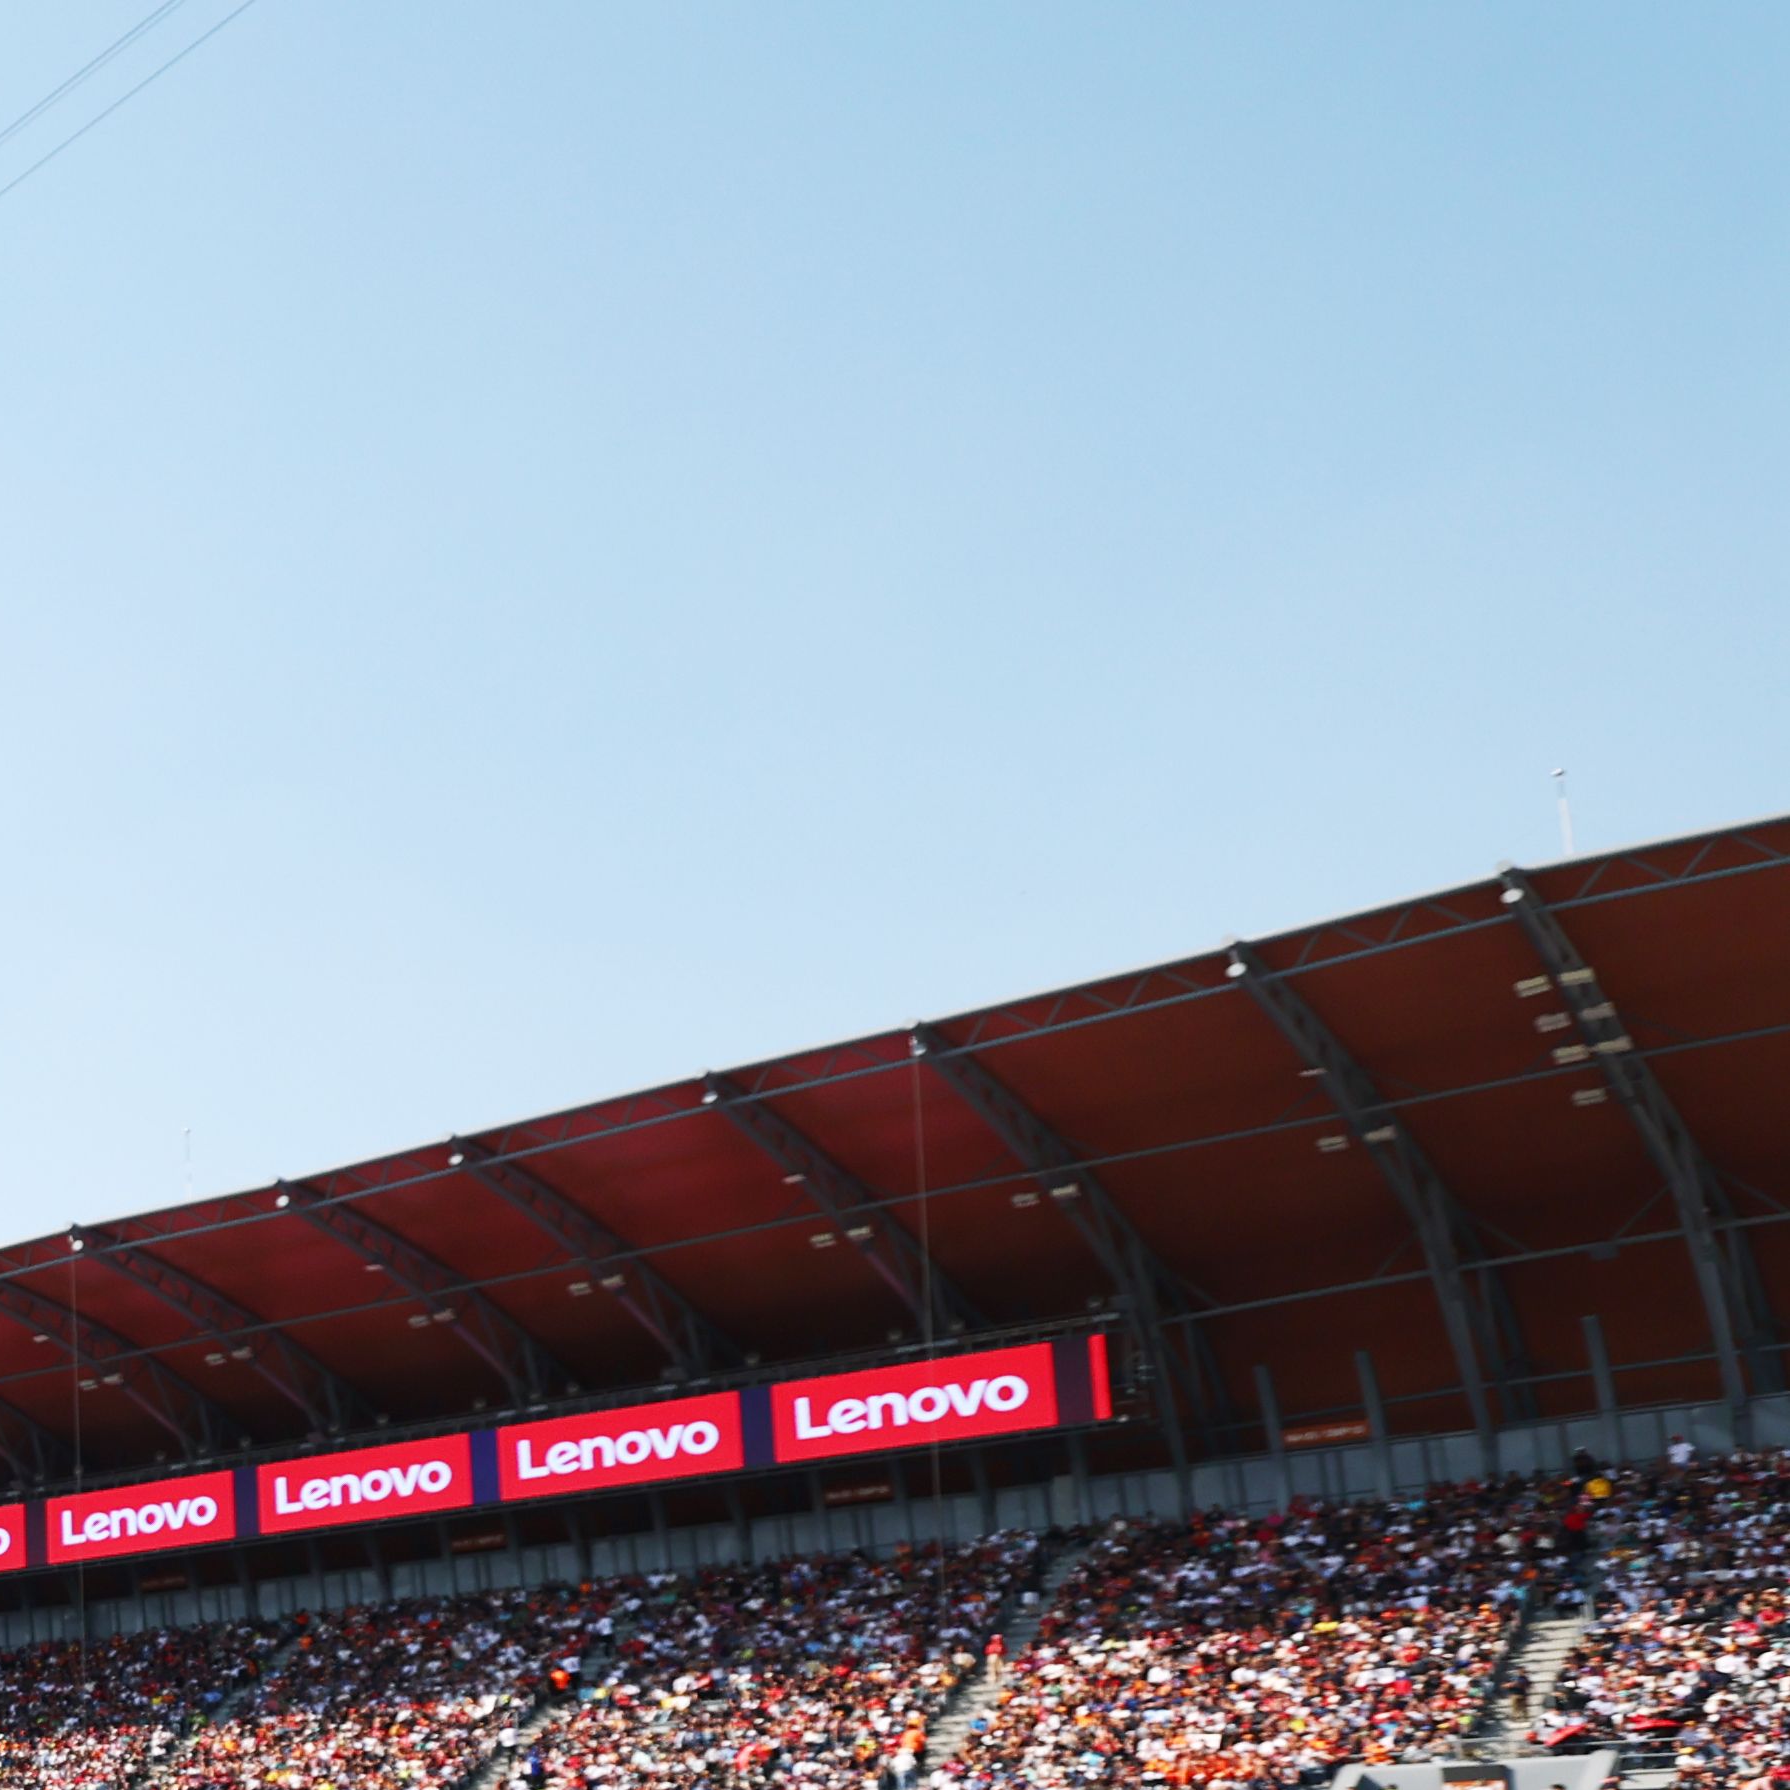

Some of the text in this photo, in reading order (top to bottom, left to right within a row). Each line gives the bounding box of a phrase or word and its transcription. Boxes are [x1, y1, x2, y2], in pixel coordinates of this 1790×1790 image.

[794, 1375, 1029, 1440] Lenovo
[517, 1421, 719, 1480] Lenovo
[275, 1460, 452, 1515] Lenovo
[61, 1496, 218, 1546] Lenovo
